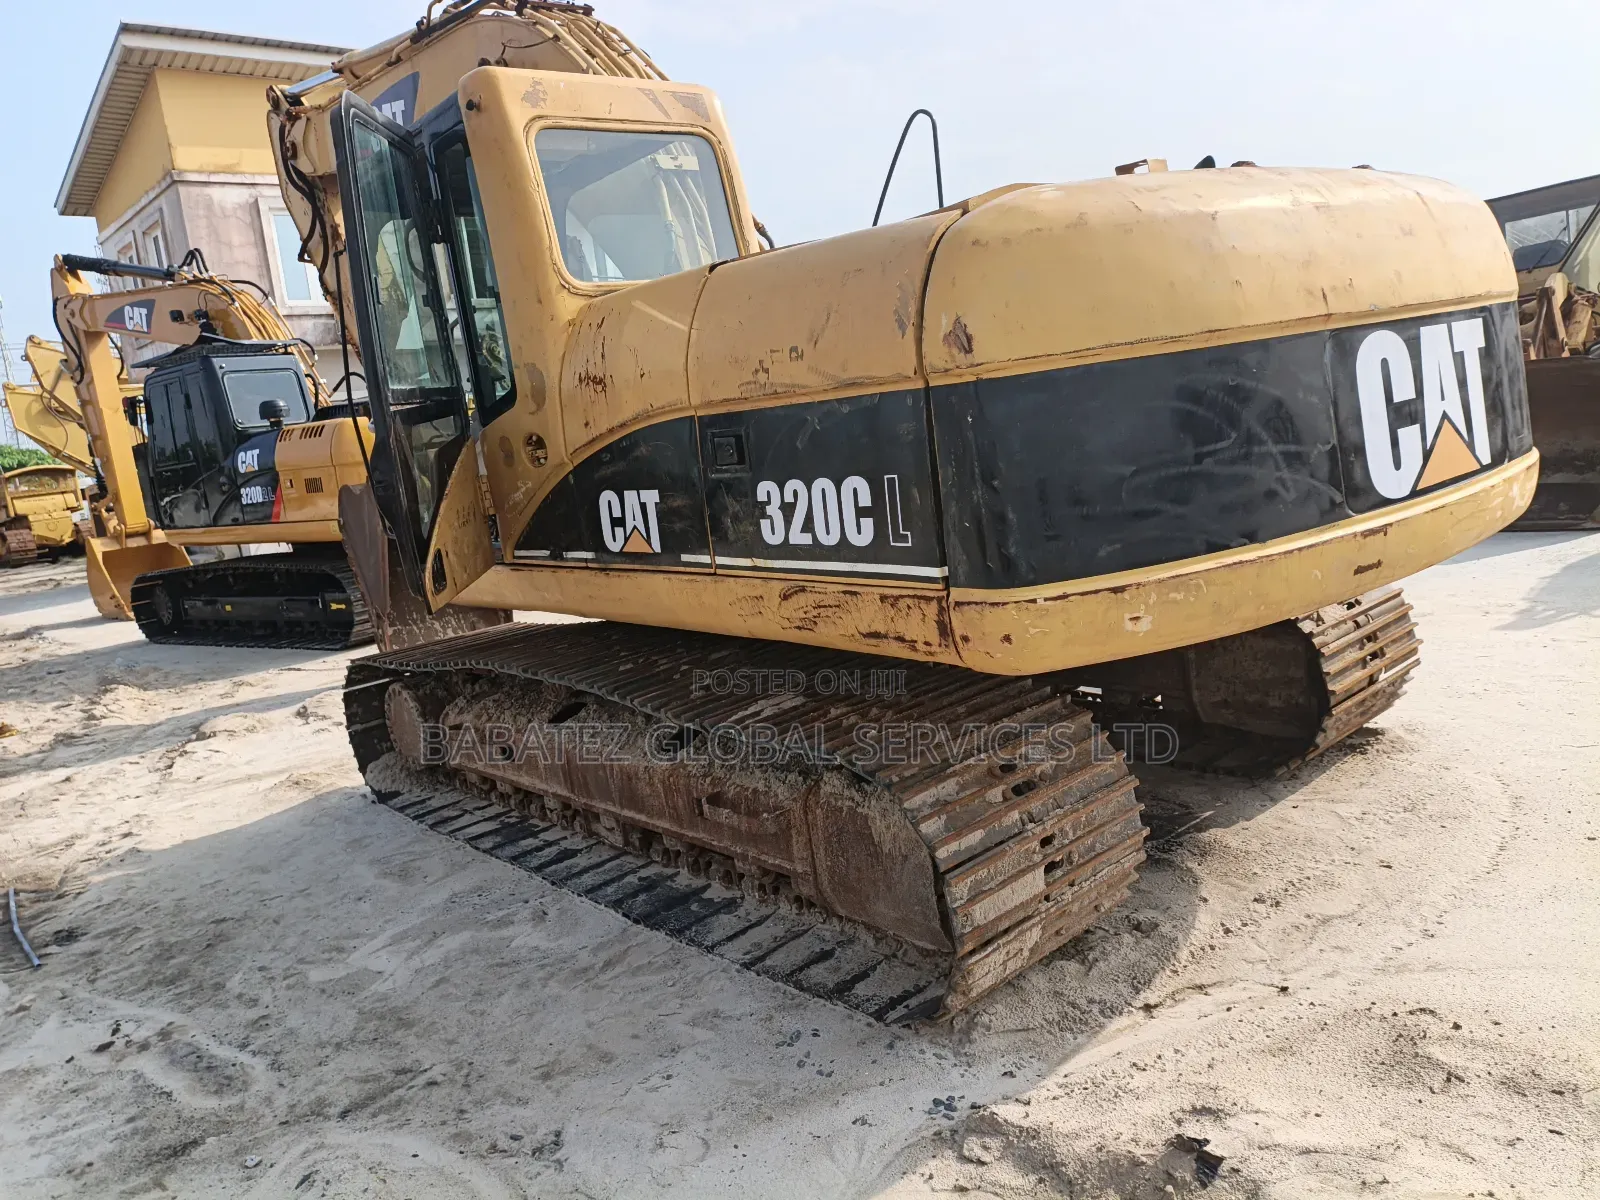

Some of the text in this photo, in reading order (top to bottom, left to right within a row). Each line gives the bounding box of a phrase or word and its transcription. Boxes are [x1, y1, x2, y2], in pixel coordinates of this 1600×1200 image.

[372, 99, 405, 126] AT
[124, 305, 148, 332] CAT
[1356, 317, 1492, 499] CAT
[238, 448, 260, 473] CAT
[598, 489, 661, 552] CAT
[756, 474, 911, 546] 320C L
